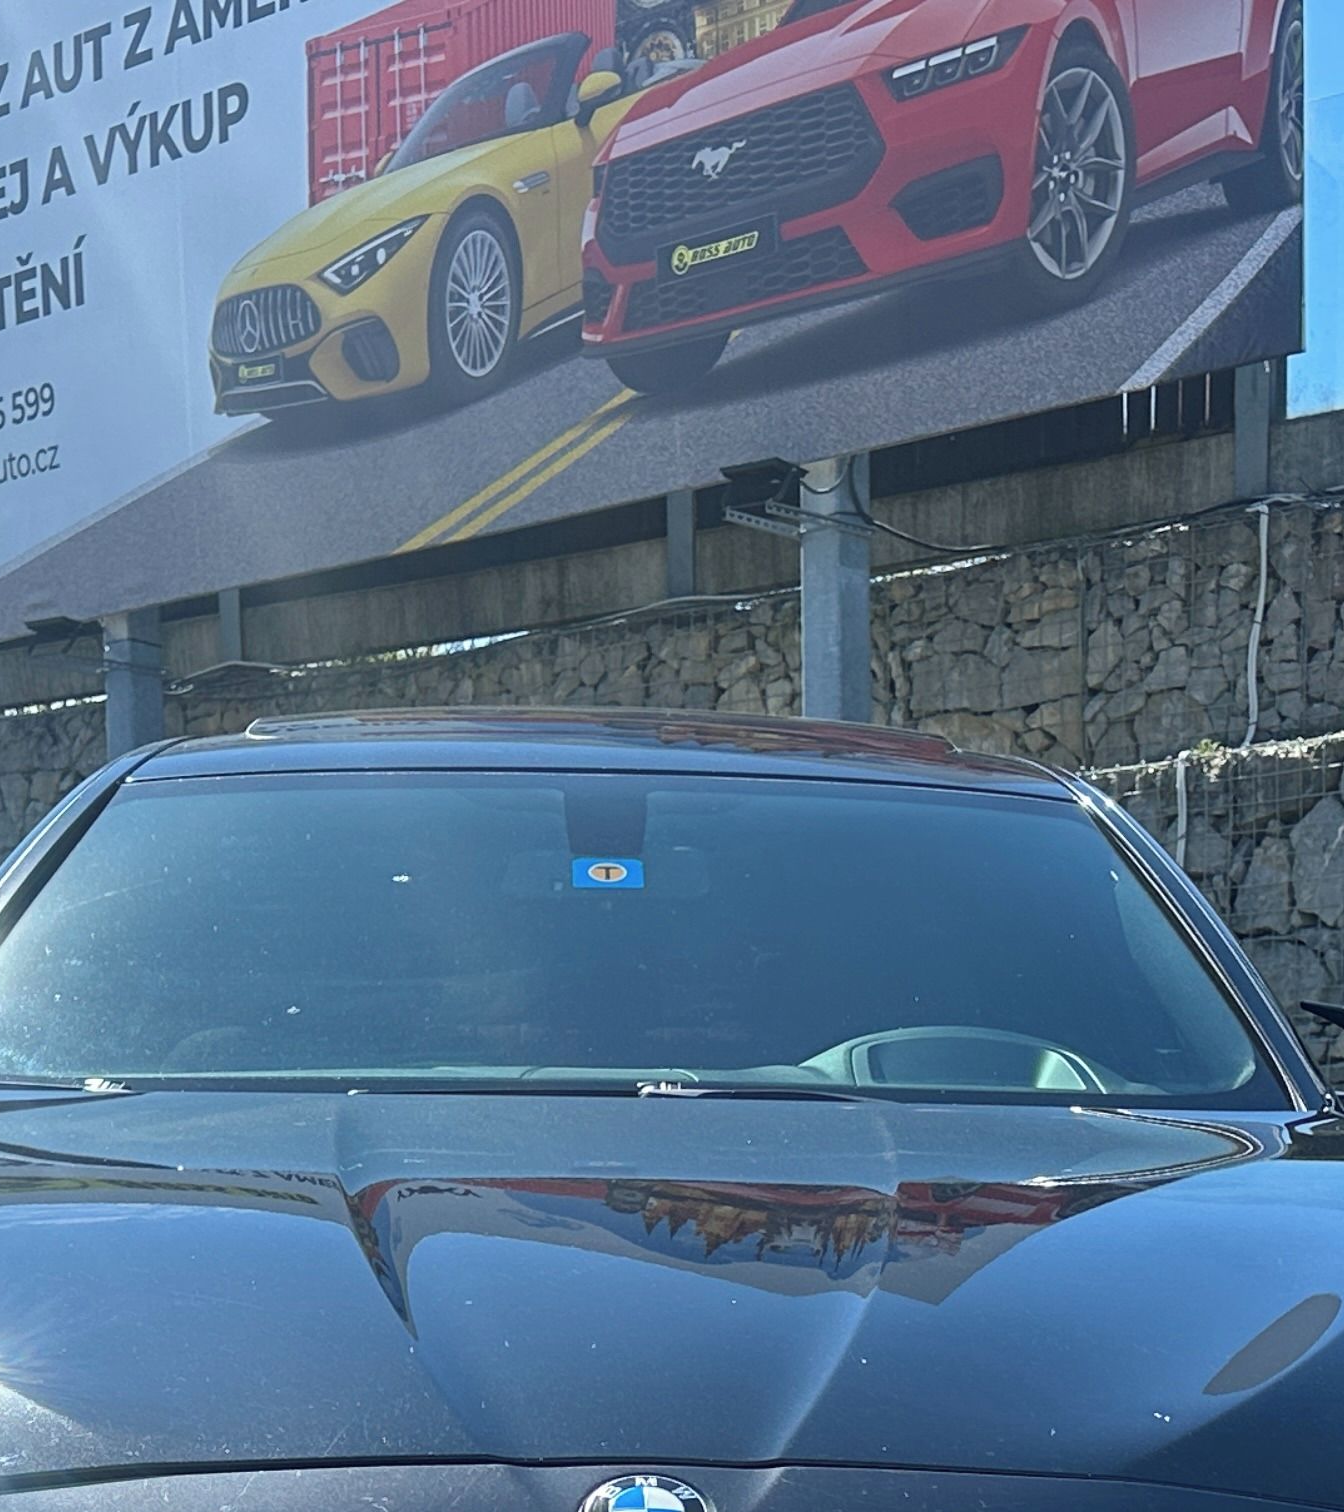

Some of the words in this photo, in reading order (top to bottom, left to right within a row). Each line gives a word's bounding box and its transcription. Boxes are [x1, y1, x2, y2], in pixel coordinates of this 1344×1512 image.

[20, 22, 111, 109] AUT
[124, 7, 153, 70] Z
[42, 145, 76, 205] A
[84, 82, 249, 186] VÝKUP
[11, 382, 55, 425] 599
[596, 1476, 698, 1500] BMW
